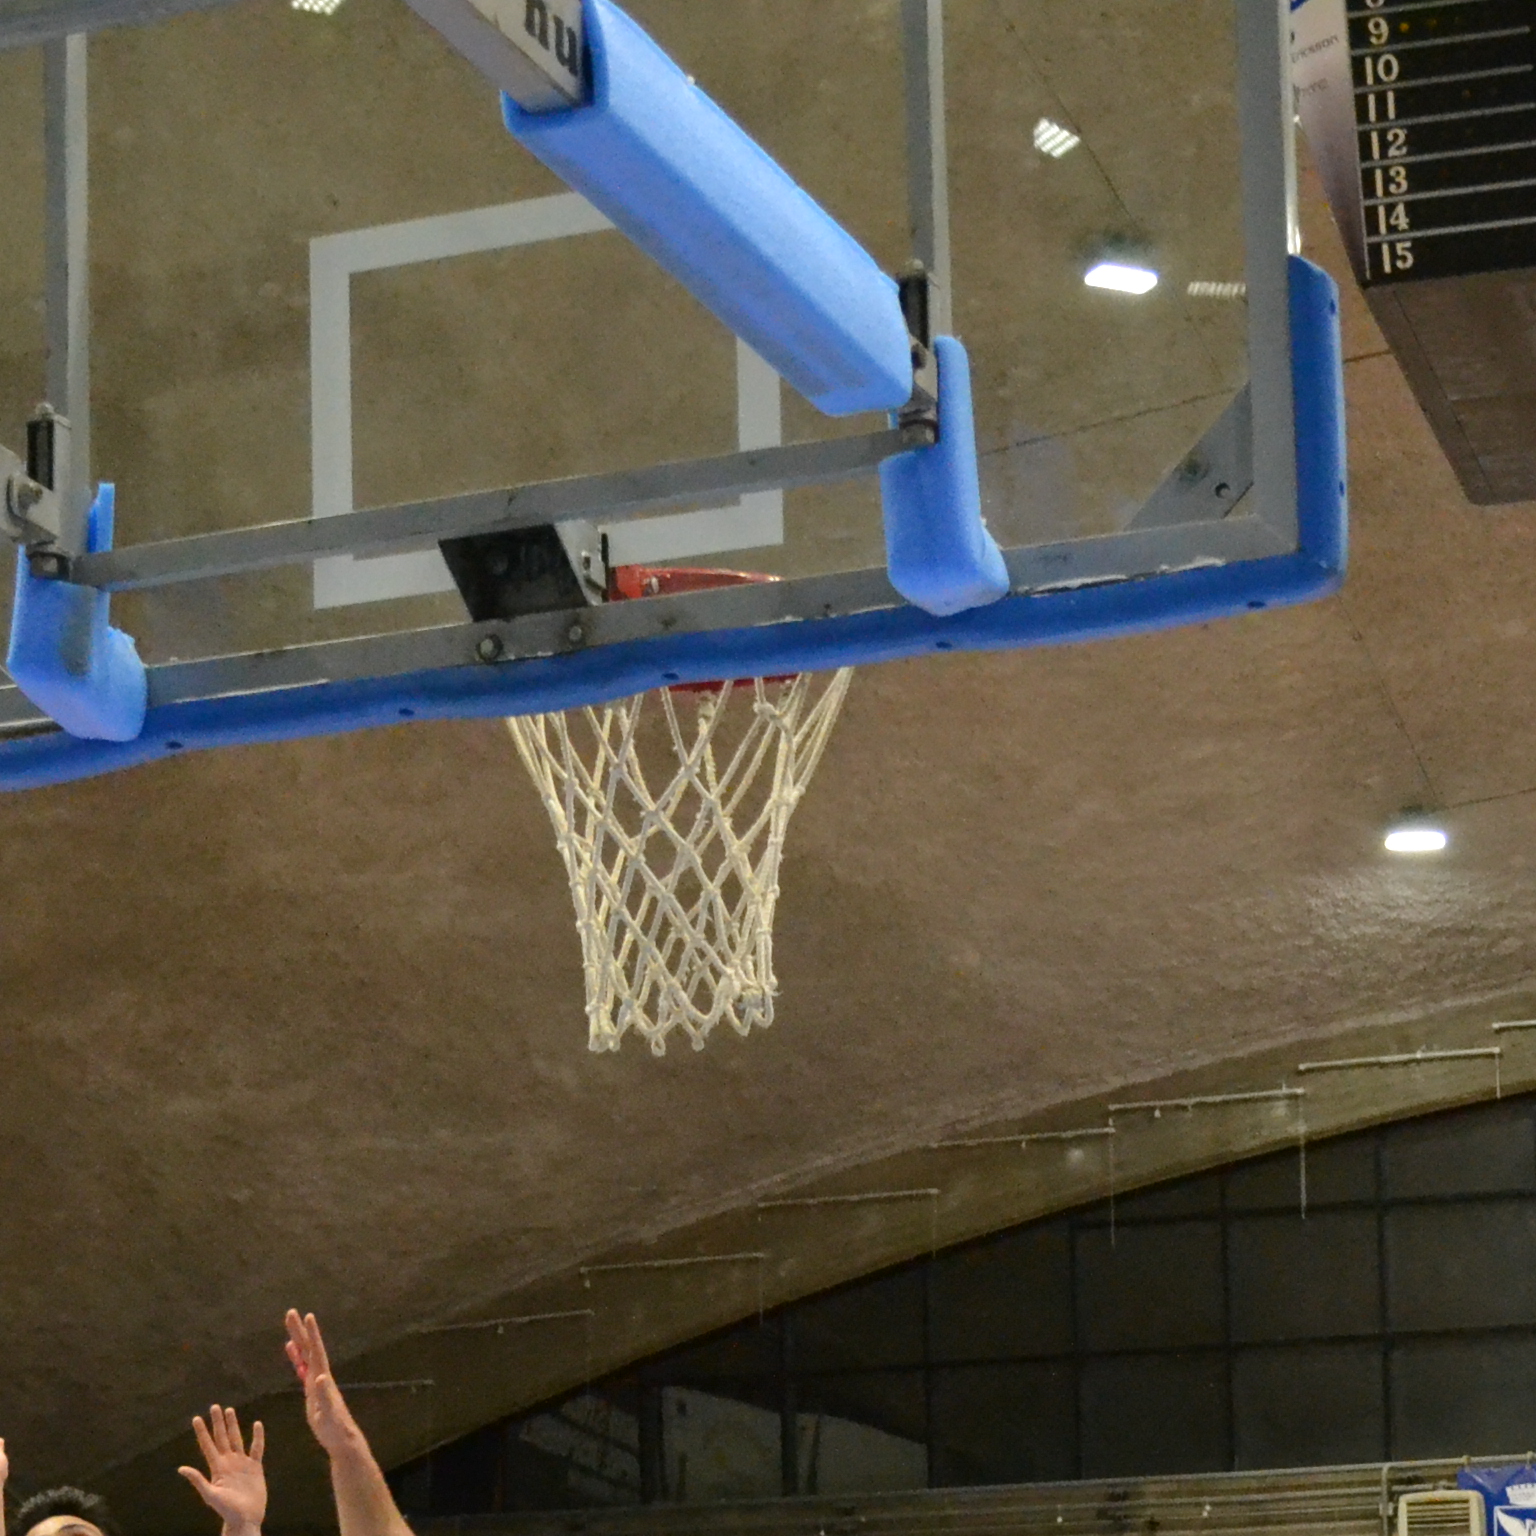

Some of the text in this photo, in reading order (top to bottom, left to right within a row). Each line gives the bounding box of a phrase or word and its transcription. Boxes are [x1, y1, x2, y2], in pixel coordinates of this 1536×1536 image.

[1368, 16, 1390, 45] 9
[1365, 53, 1400, 86] 10
[1367, 90, 1396, 123] 11
[1371, 127, 1409, 160] 12
[1375, 165, 1409, 198] 13
[1378, 202, 1411, 235] 14
[1382, 241, 1415, 274] 15
